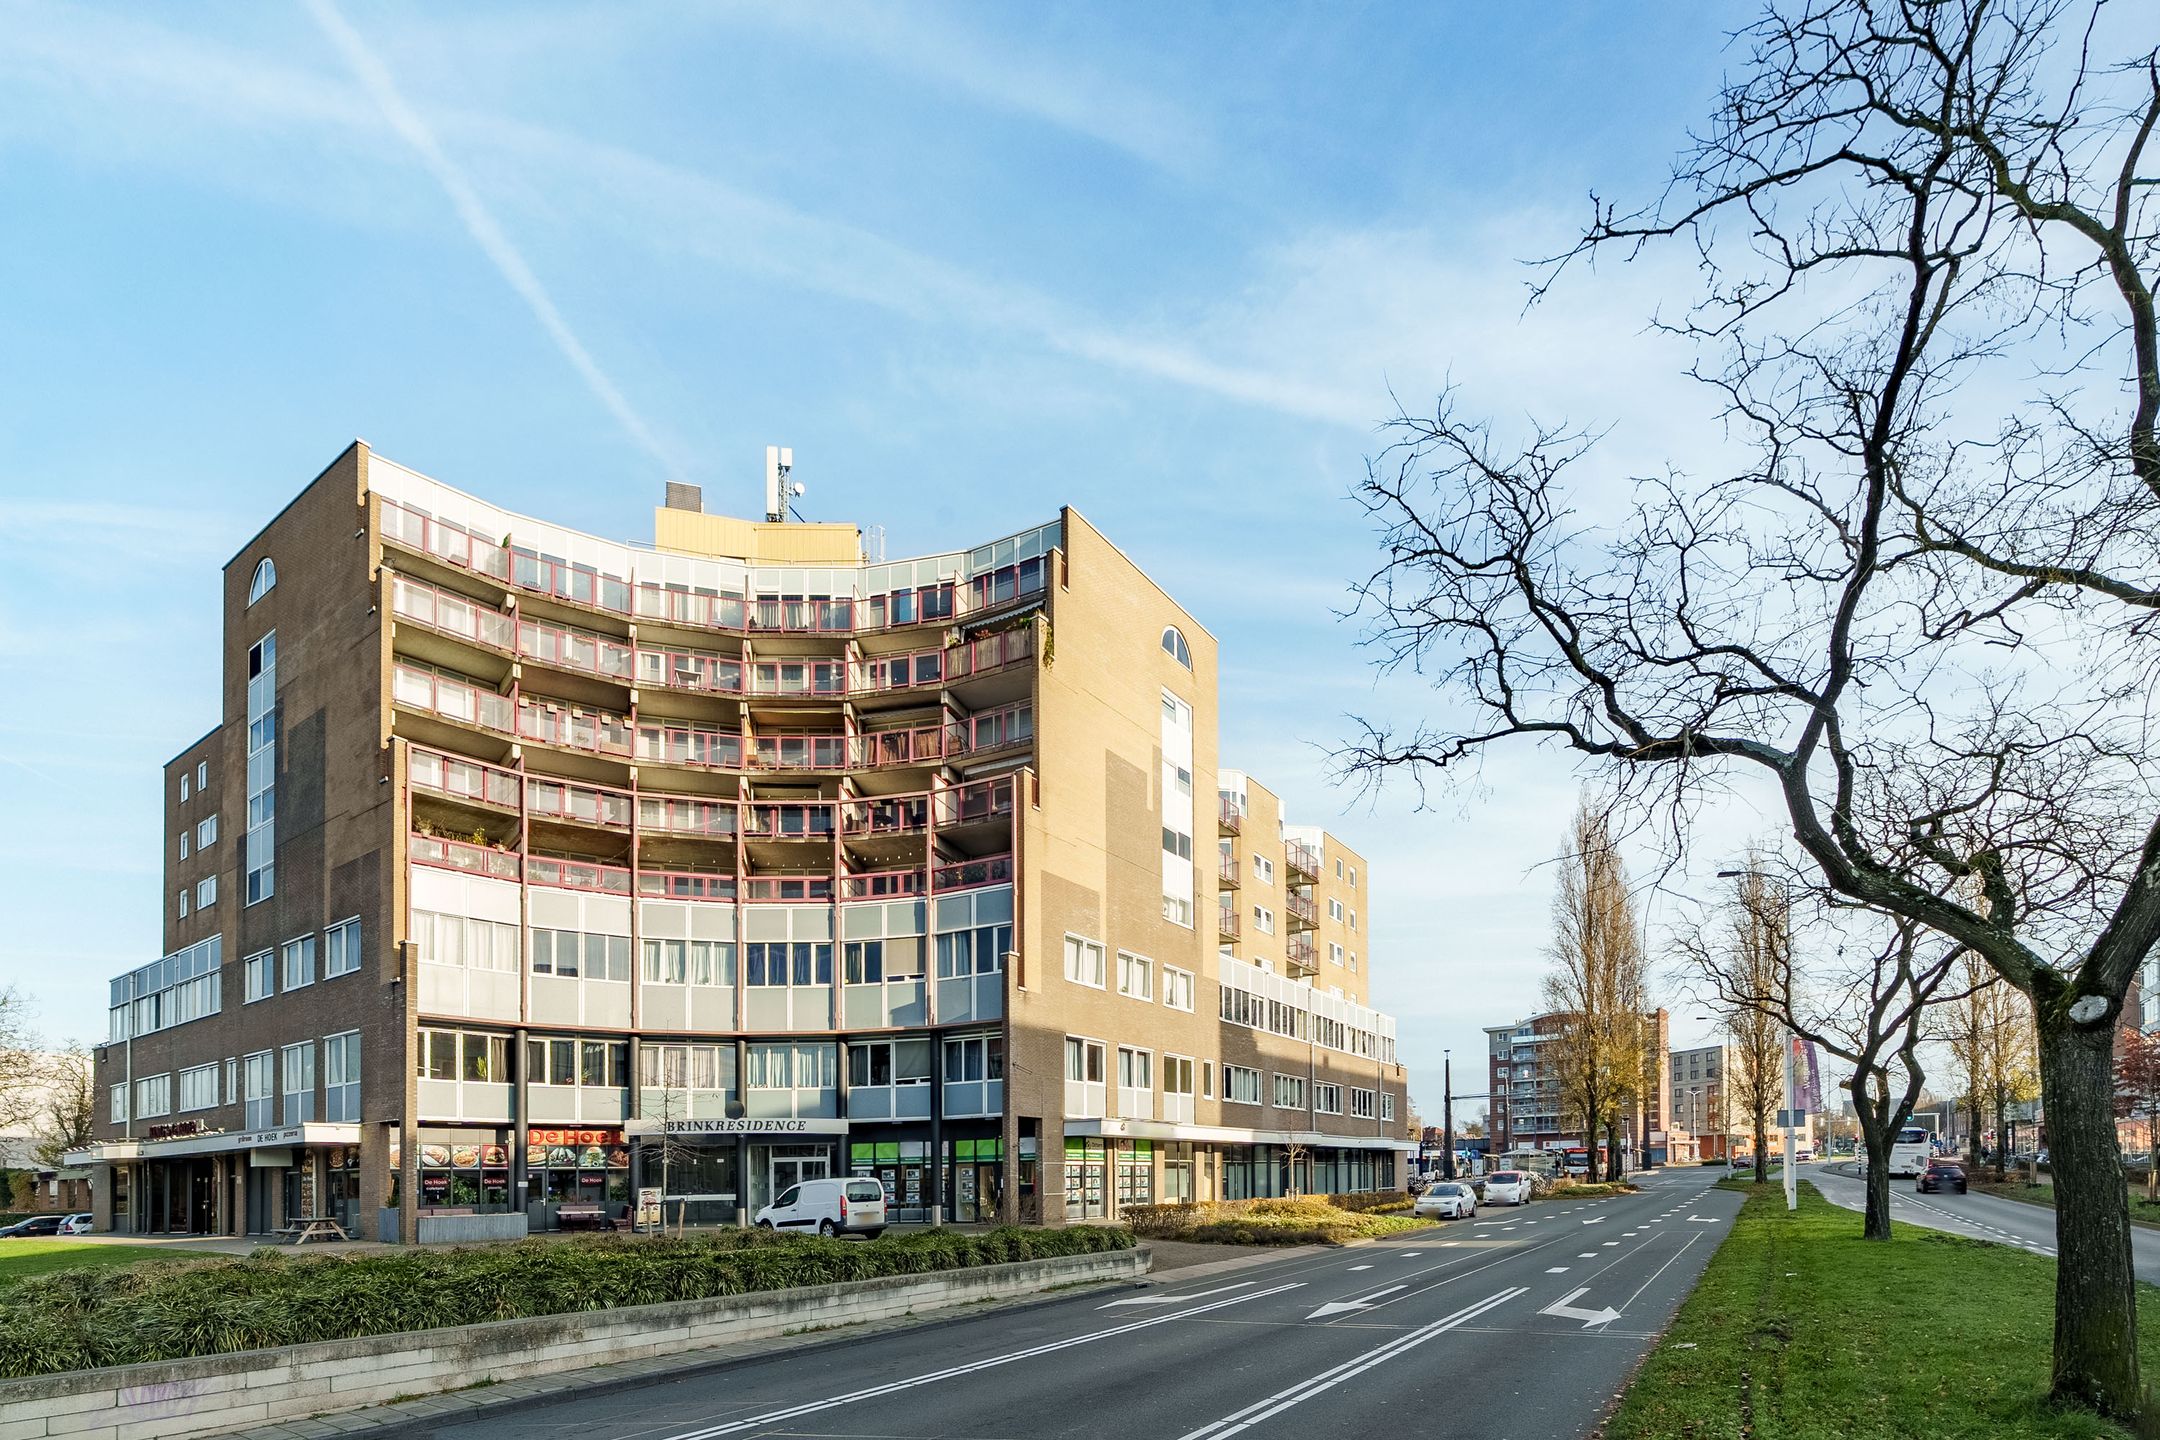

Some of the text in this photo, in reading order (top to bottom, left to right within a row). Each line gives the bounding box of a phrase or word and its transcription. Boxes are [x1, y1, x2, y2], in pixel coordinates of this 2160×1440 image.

[667, 1120, 807, 1132] BRINKRESIDENCE
[258, 1134, 263, 1142] DE
[265, 1132, 277, 1141] HOEK
[529, 1129, 558, 1145] De
